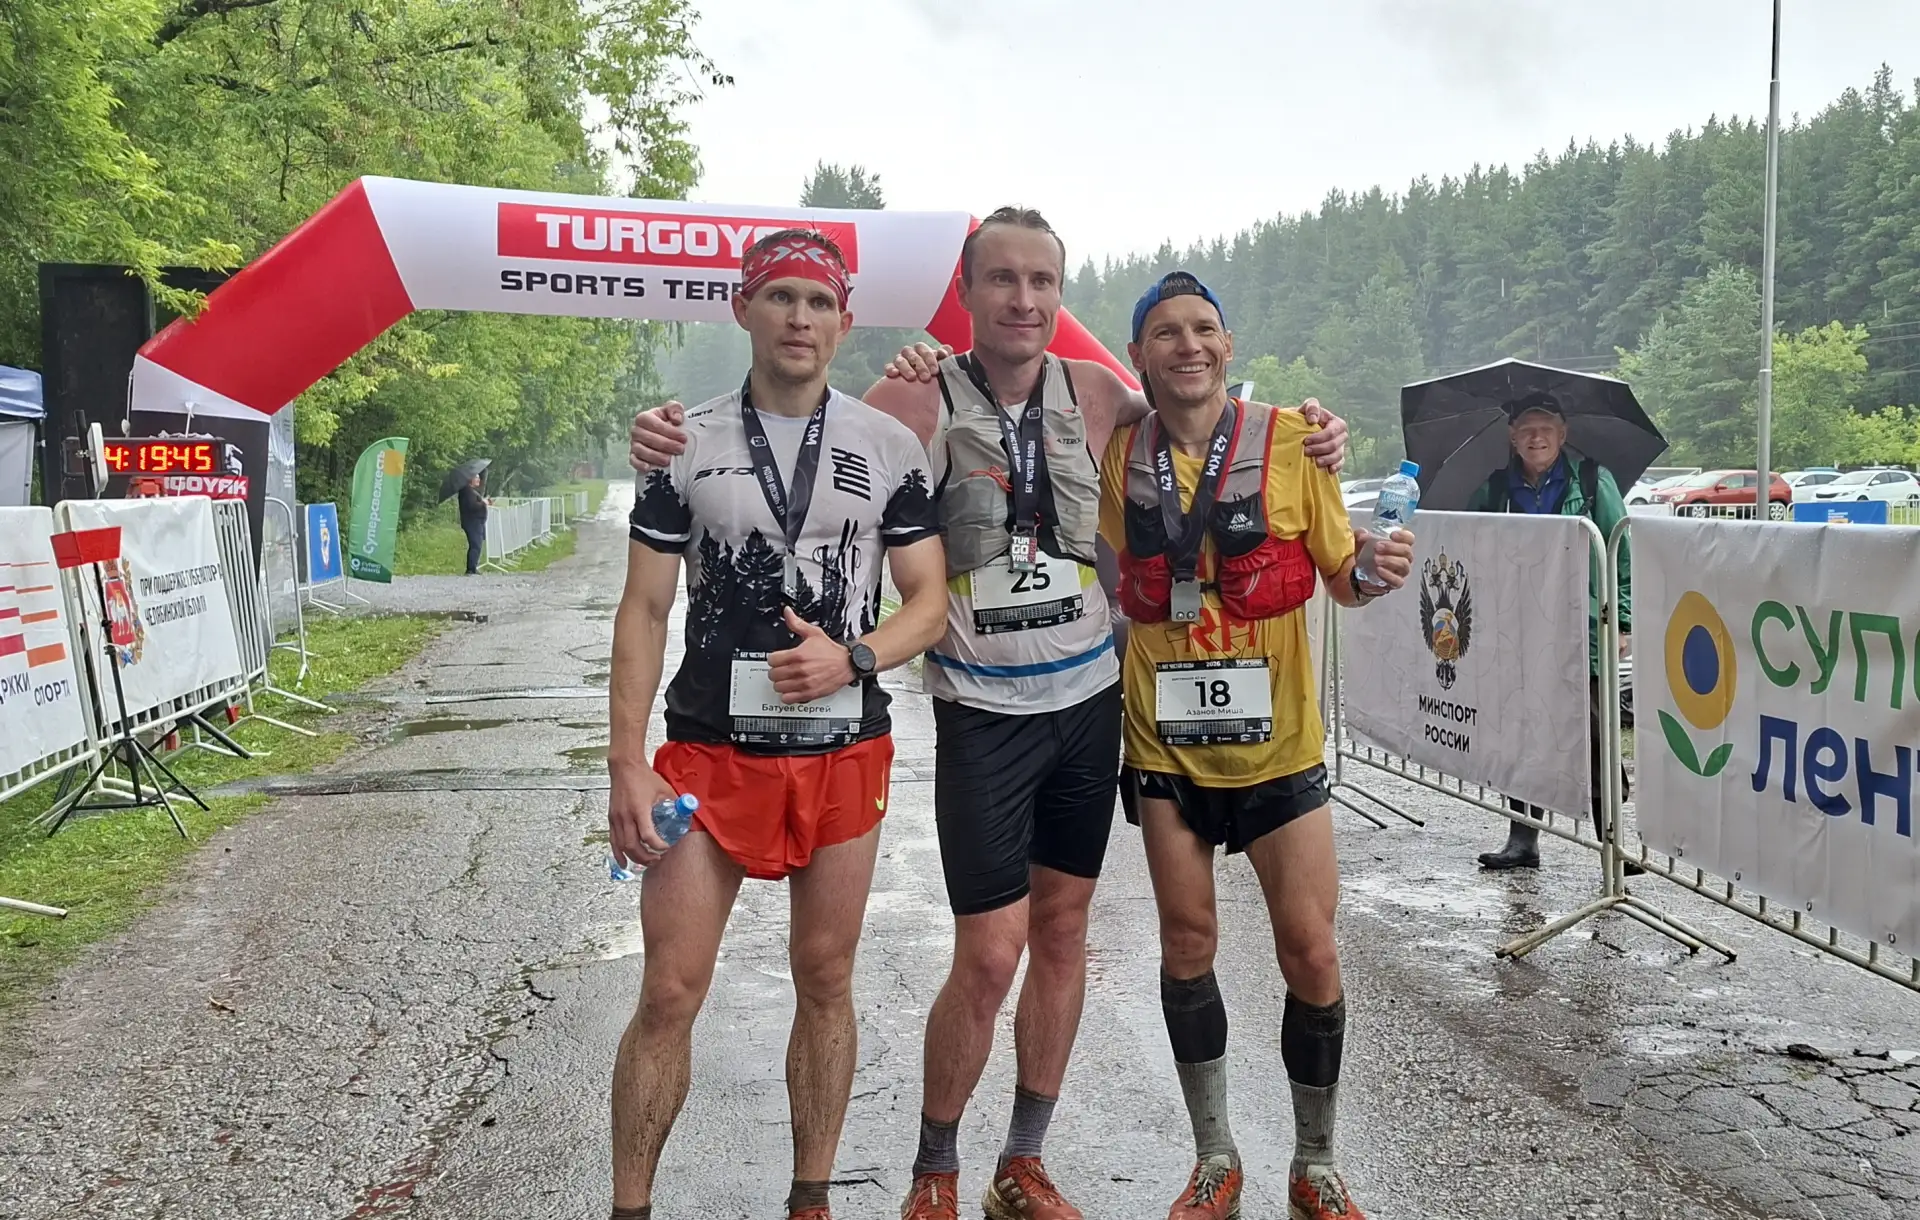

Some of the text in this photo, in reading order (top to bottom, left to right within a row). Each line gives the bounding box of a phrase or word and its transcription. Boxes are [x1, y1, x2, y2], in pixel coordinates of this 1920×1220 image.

[536, 213, 792, 258] TURGOY
[501, 270, 645, 298] SPORTS
[1026, 458, 1035, 482] ЧИСТОЙ
[1205, 434, 1228, 477] 42 KM
[1156, 450, 1173, 492] 42 KM
[1025, 482, 1033, 494] БЕГ
[1011, 544, 1029, 555] GO
[1008, 562, 1051, 594] 25
[1194, 680, 1232, 707] 18
[761, 703, 832, 714] Батуев Сергей
[1186, 707, 1244, 717] Азанов Миша
[1419, 693, 1477, 727] МИНСПОРТ
[1424, 723, 1470, 754] РОССИИ
[1751, 713, 1920, 838] лен
